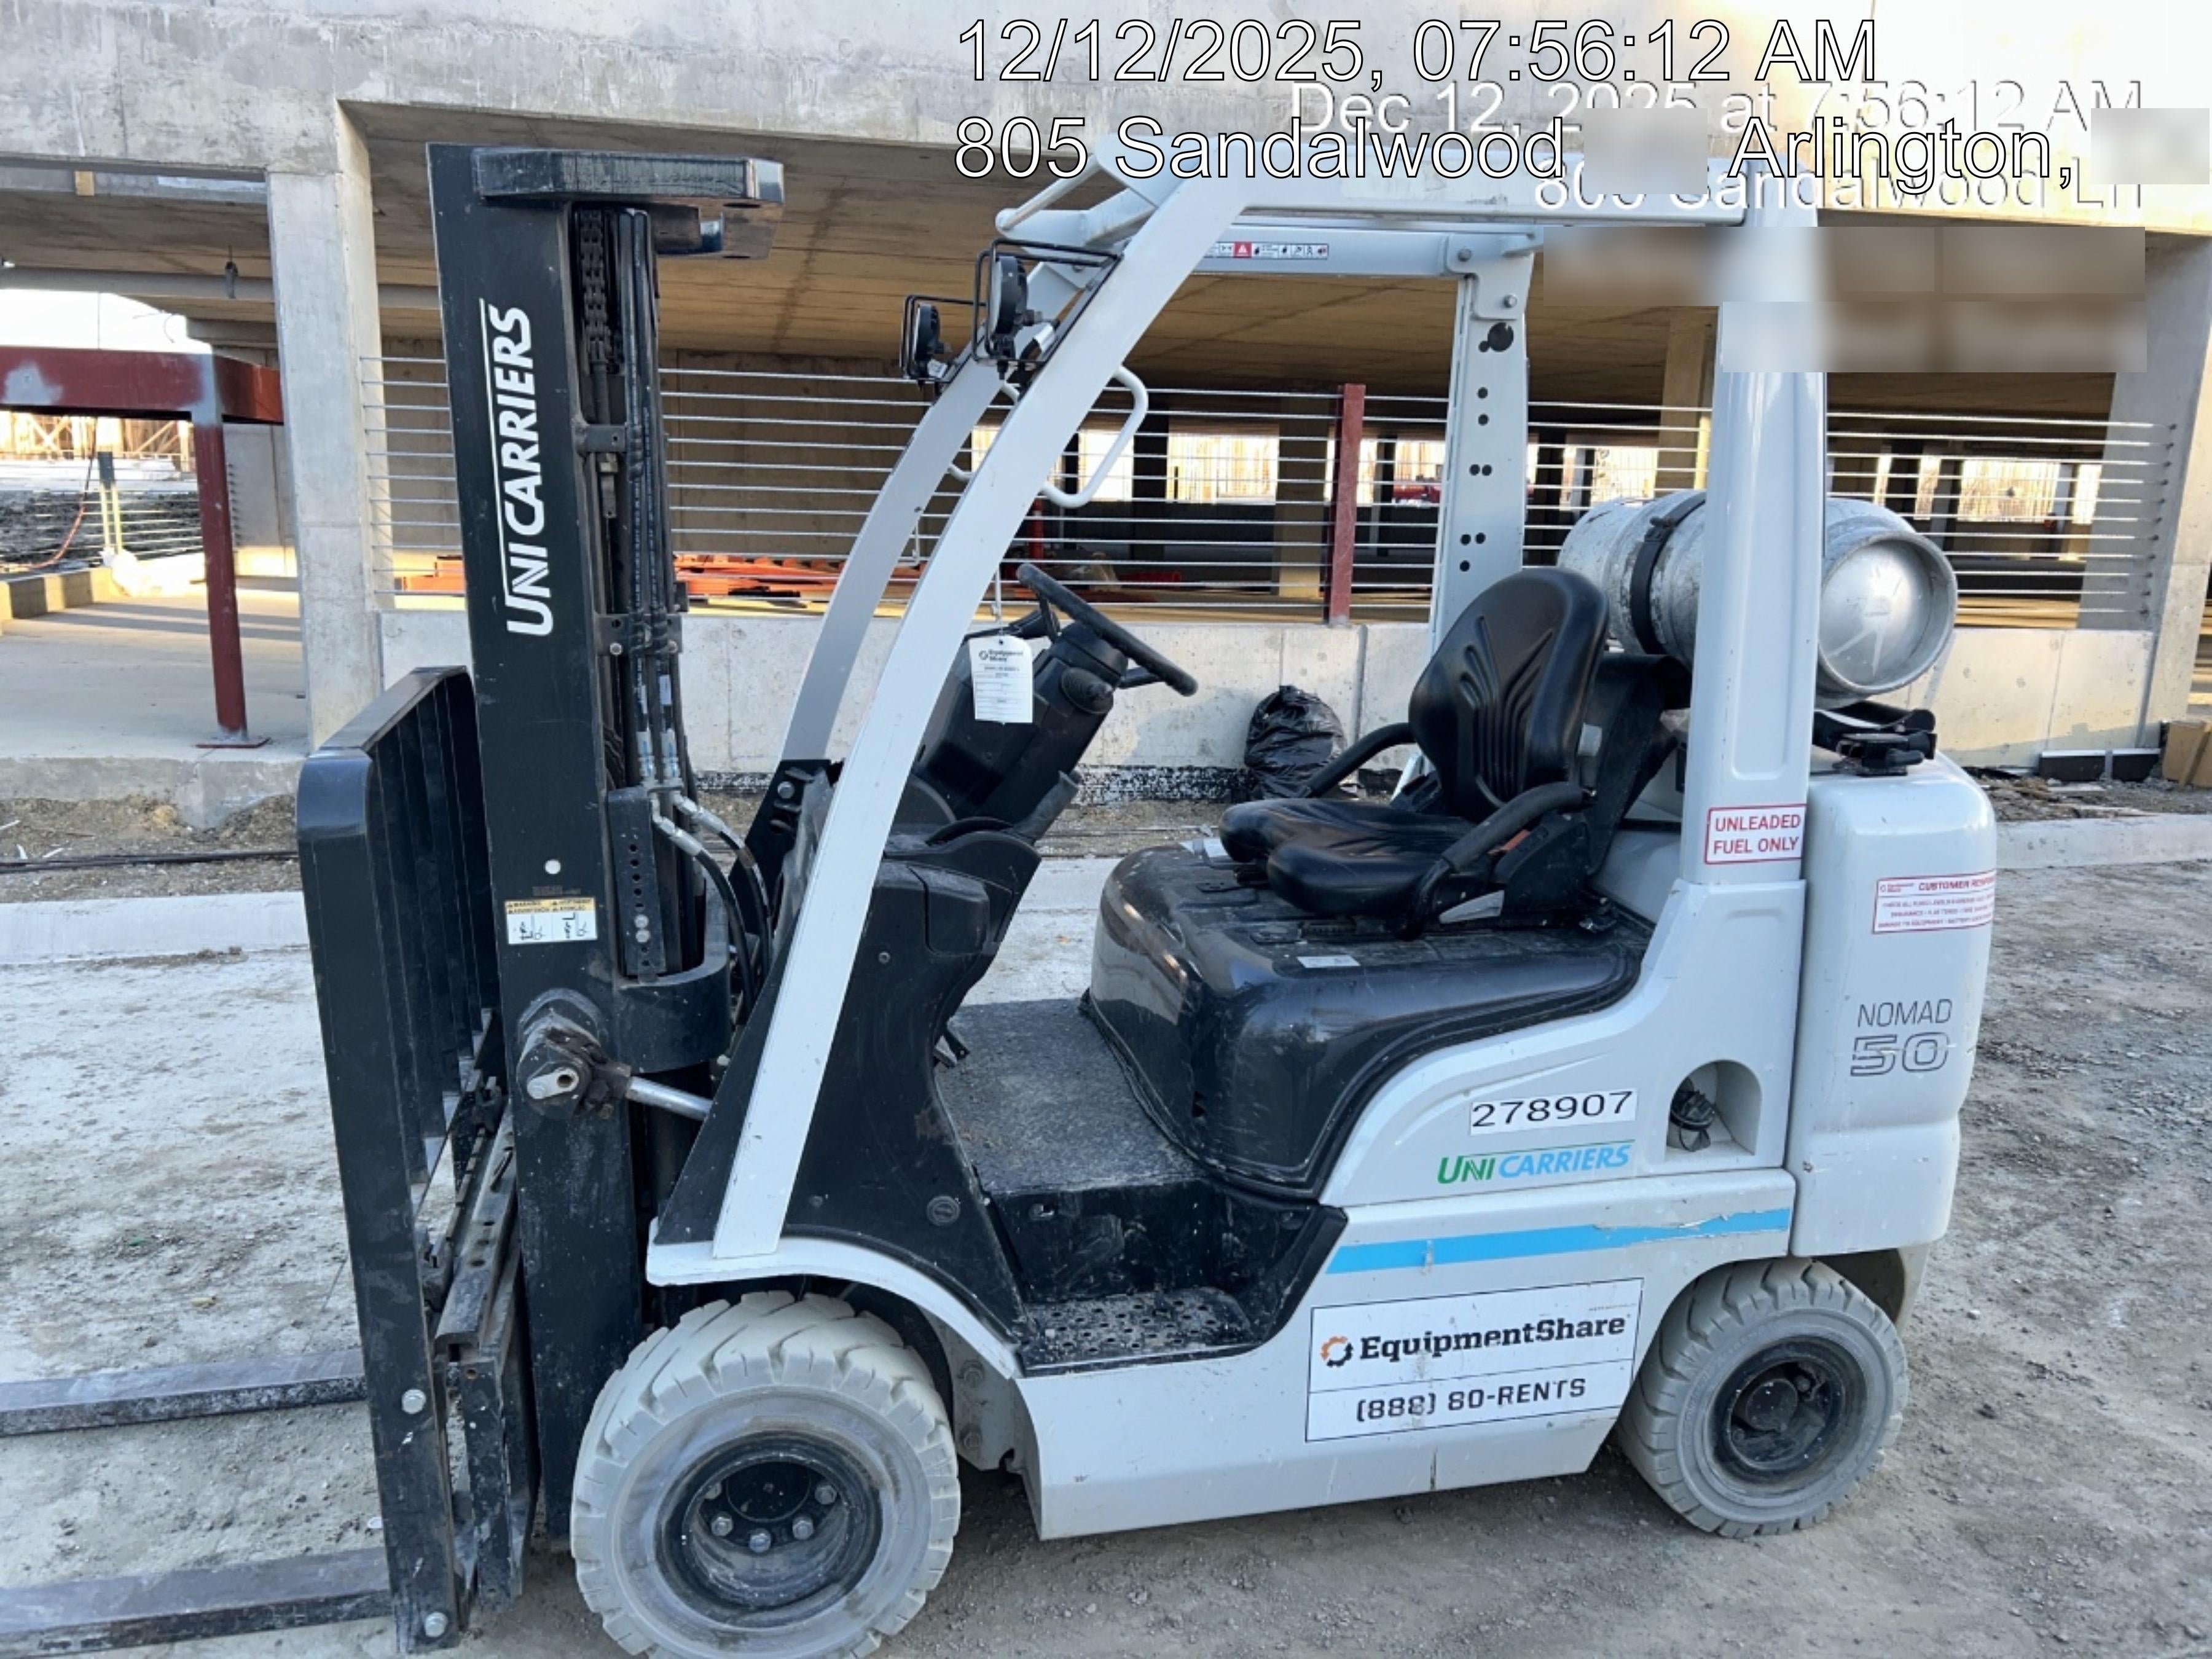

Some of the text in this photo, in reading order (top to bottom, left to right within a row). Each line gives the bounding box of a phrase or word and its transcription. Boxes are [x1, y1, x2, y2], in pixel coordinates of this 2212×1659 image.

[1715, 814, 1802, 831] UNLEADED
[1714, 836, 1799, 855] FUEL ONLY
[1857, 998, 1953, 1027] NOMAD
[1851, 1032, 1950, 1076] 50
[1472, 1091, 1633, 1127] 278907
[1359, 1316, 1626, 1362] EquipmentShare
[1447, 1378, 1587, 1411] 80-RENTS
